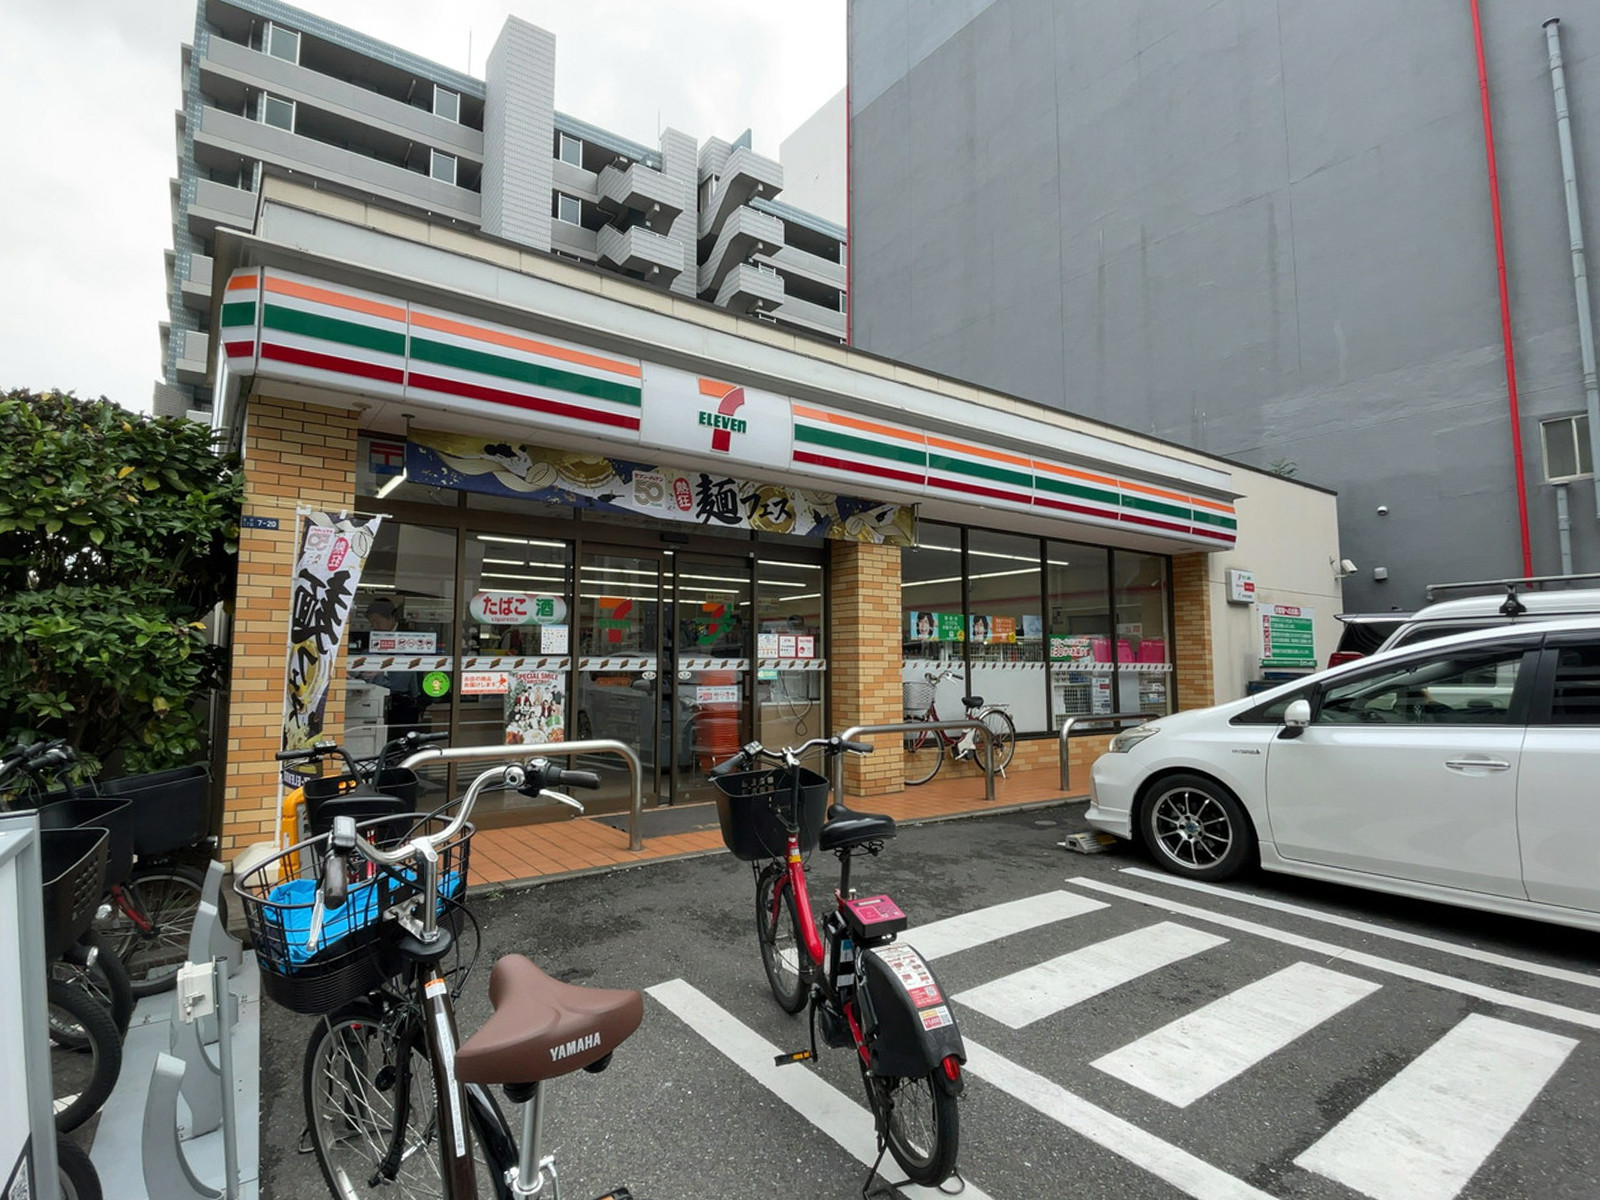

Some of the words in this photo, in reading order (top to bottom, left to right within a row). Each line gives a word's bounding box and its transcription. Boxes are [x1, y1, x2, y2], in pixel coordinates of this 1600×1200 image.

[634, 479, 664, 505] 50
[256, 519, 277, 528] 7-20
[483, 596, 527, 616] たばこ
[535, 598, 554, 617] 酒
[515, 673, 540, 681] SPECIAL
[549, 1032, 601, 1062] YAMAHA
